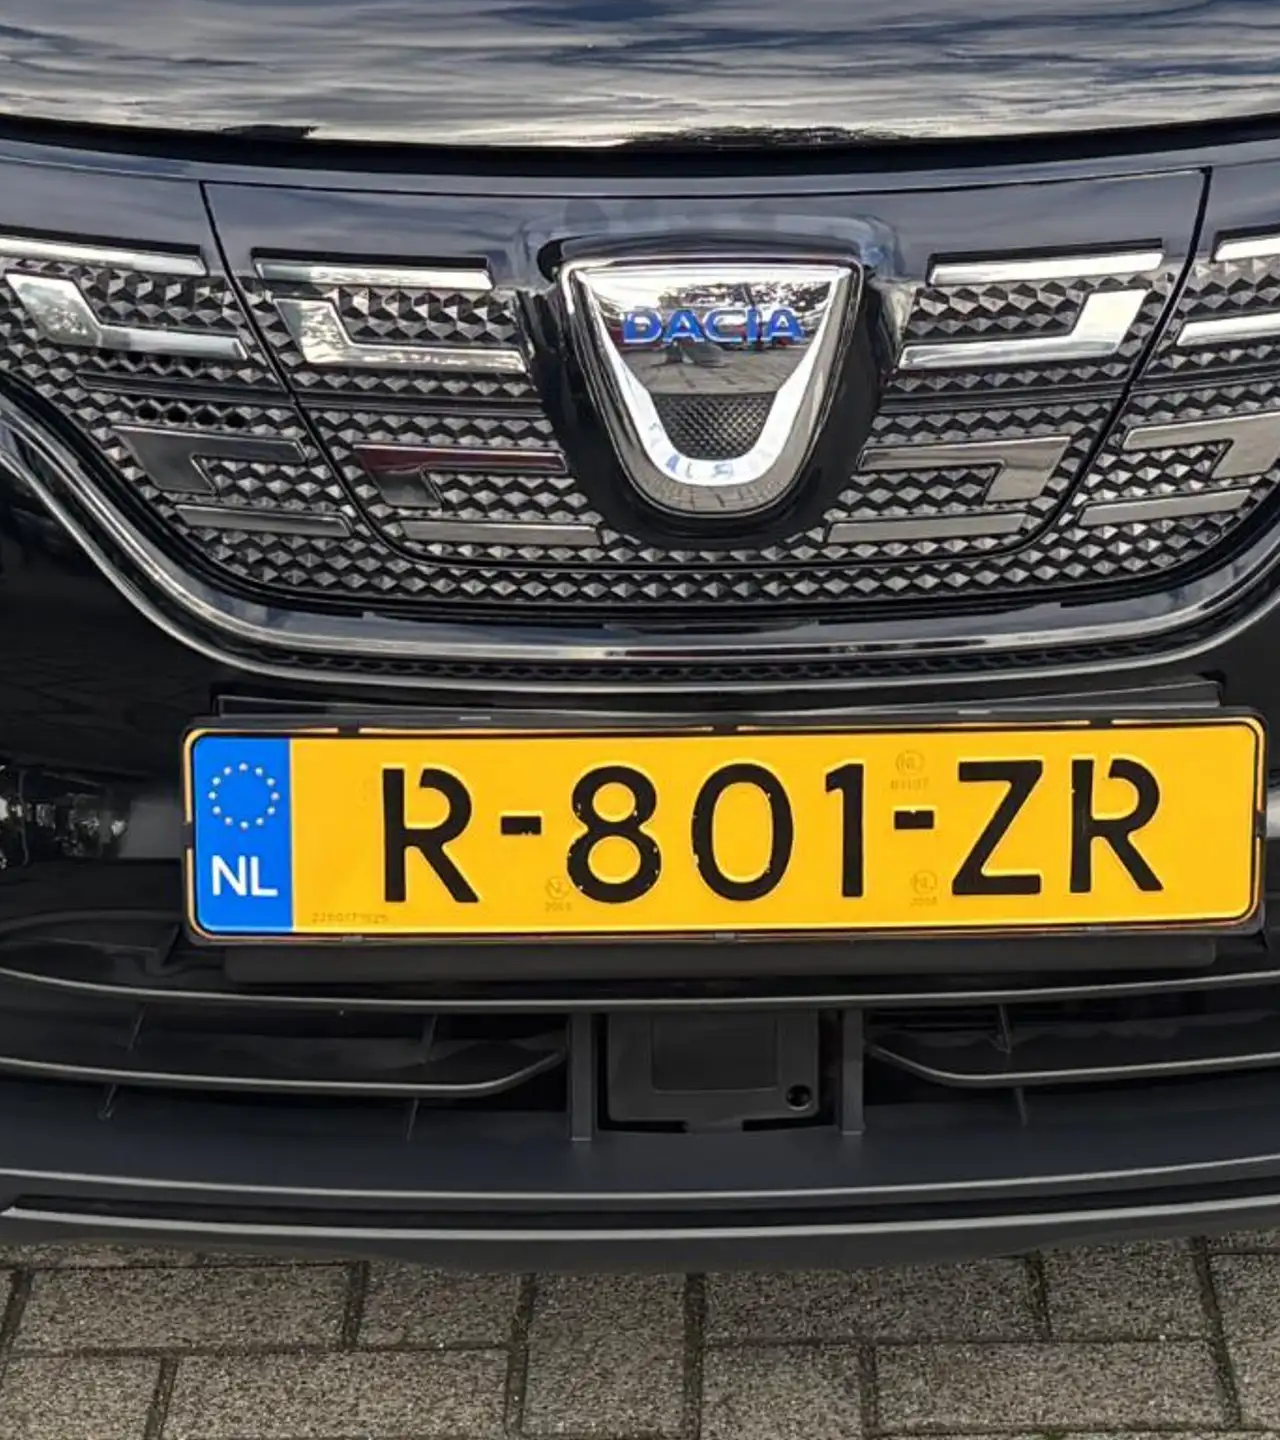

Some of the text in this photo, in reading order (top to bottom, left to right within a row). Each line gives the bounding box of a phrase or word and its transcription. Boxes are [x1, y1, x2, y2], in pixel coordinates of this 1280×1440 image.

[622, 306, 807, 344] DACIA
[211, 757, 1165, 905] NL R-801-ZR
